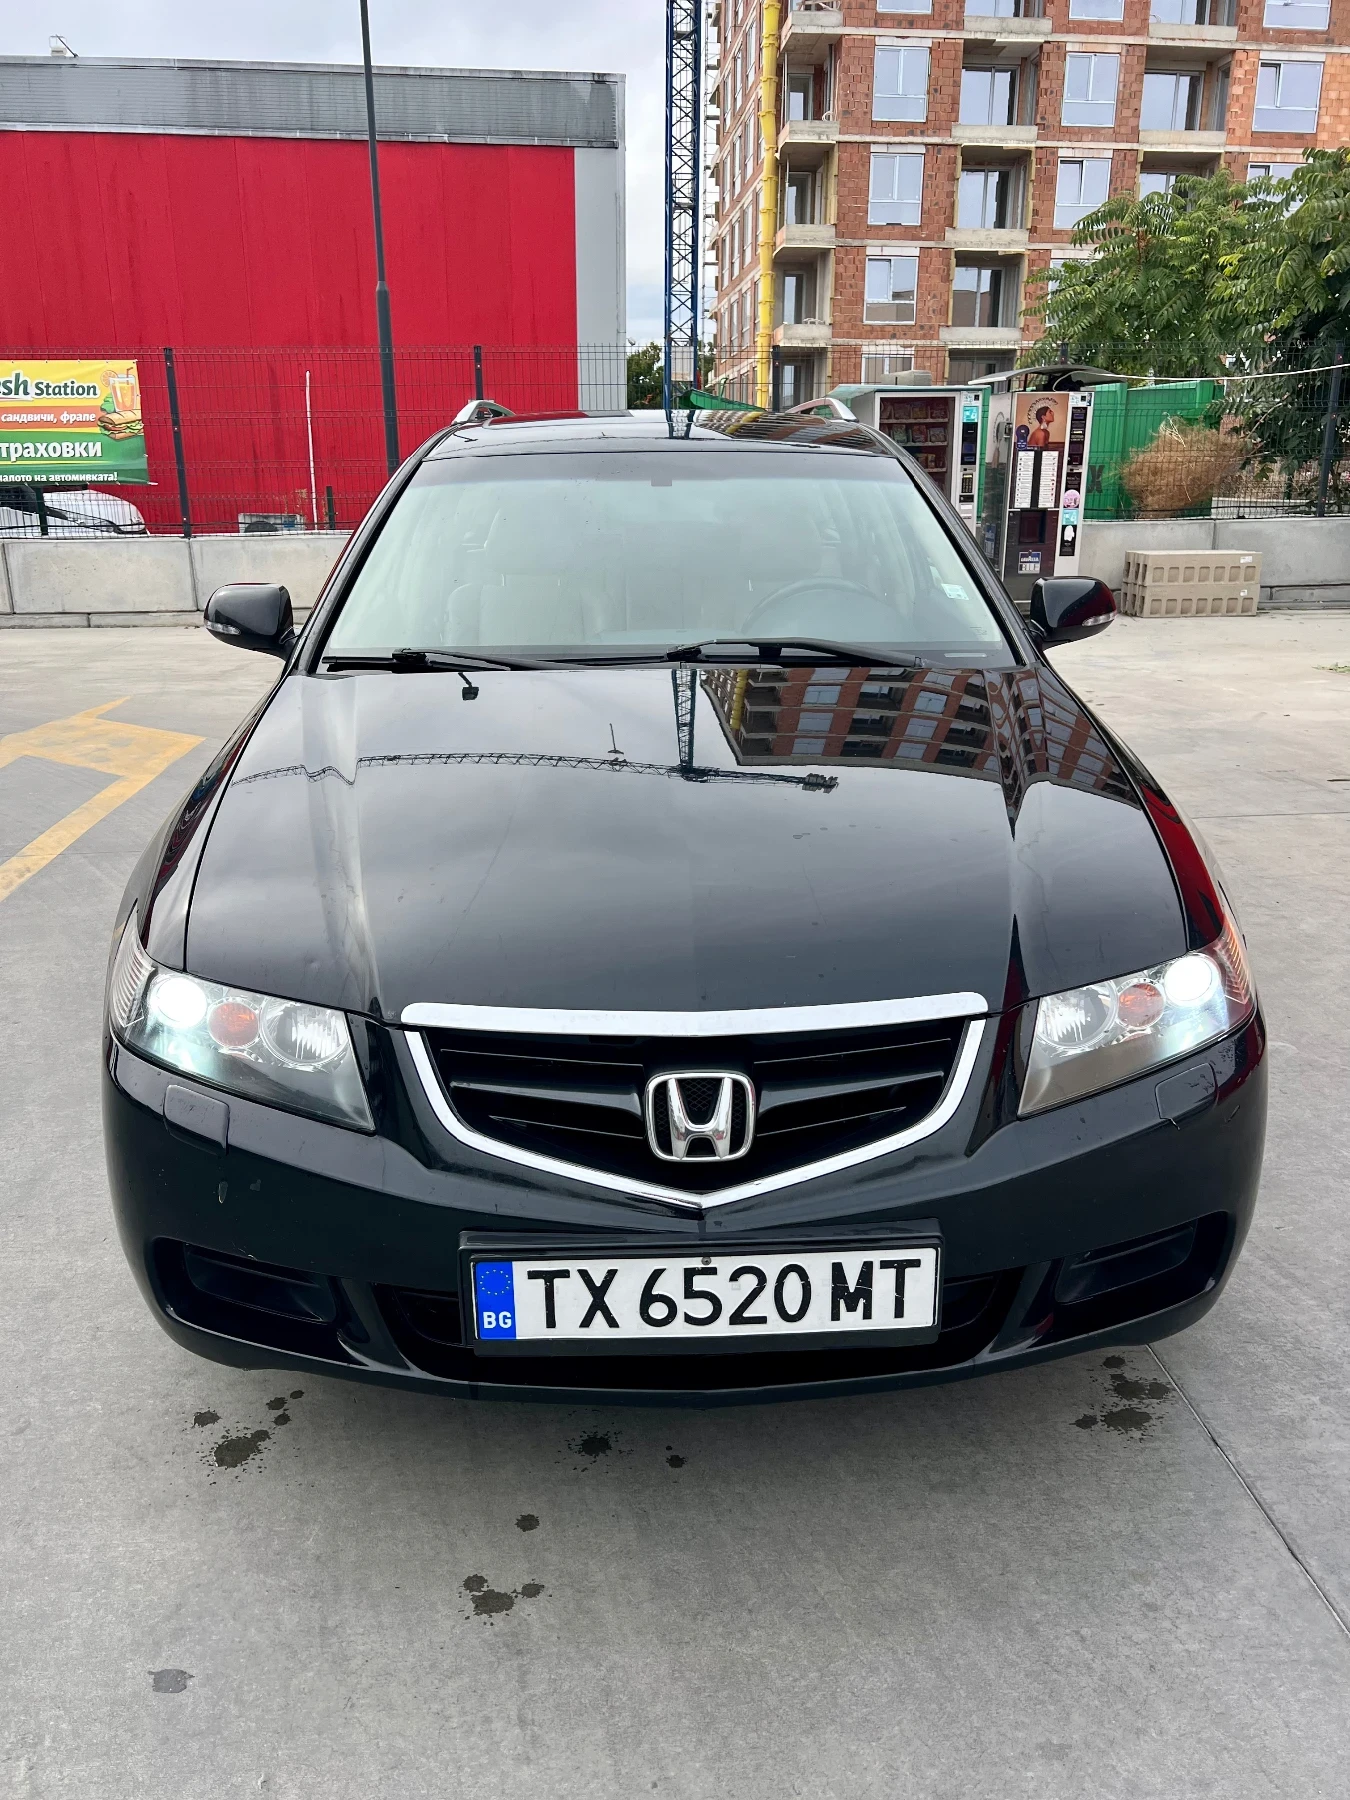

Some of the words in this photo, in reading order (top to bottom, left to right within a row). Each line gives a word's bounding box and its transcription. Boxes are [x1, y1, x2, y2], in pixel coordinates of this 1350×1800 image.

[0, 373, 30, 396] sh
[34, 381, 98, 396] Station
[1, 413, 57, 423] сандвичи,
[60, 411, 96, 424] фрапе
[34, 474, 47, 482] на
[49, 472, 118, 481] автомивката!
[527, 1268, 620, 1328] TX
[639, 1264, 812, 1328] 6520
[831, 1259, 922, 1322] MT
[483, 1311, 512, 1328] BG
